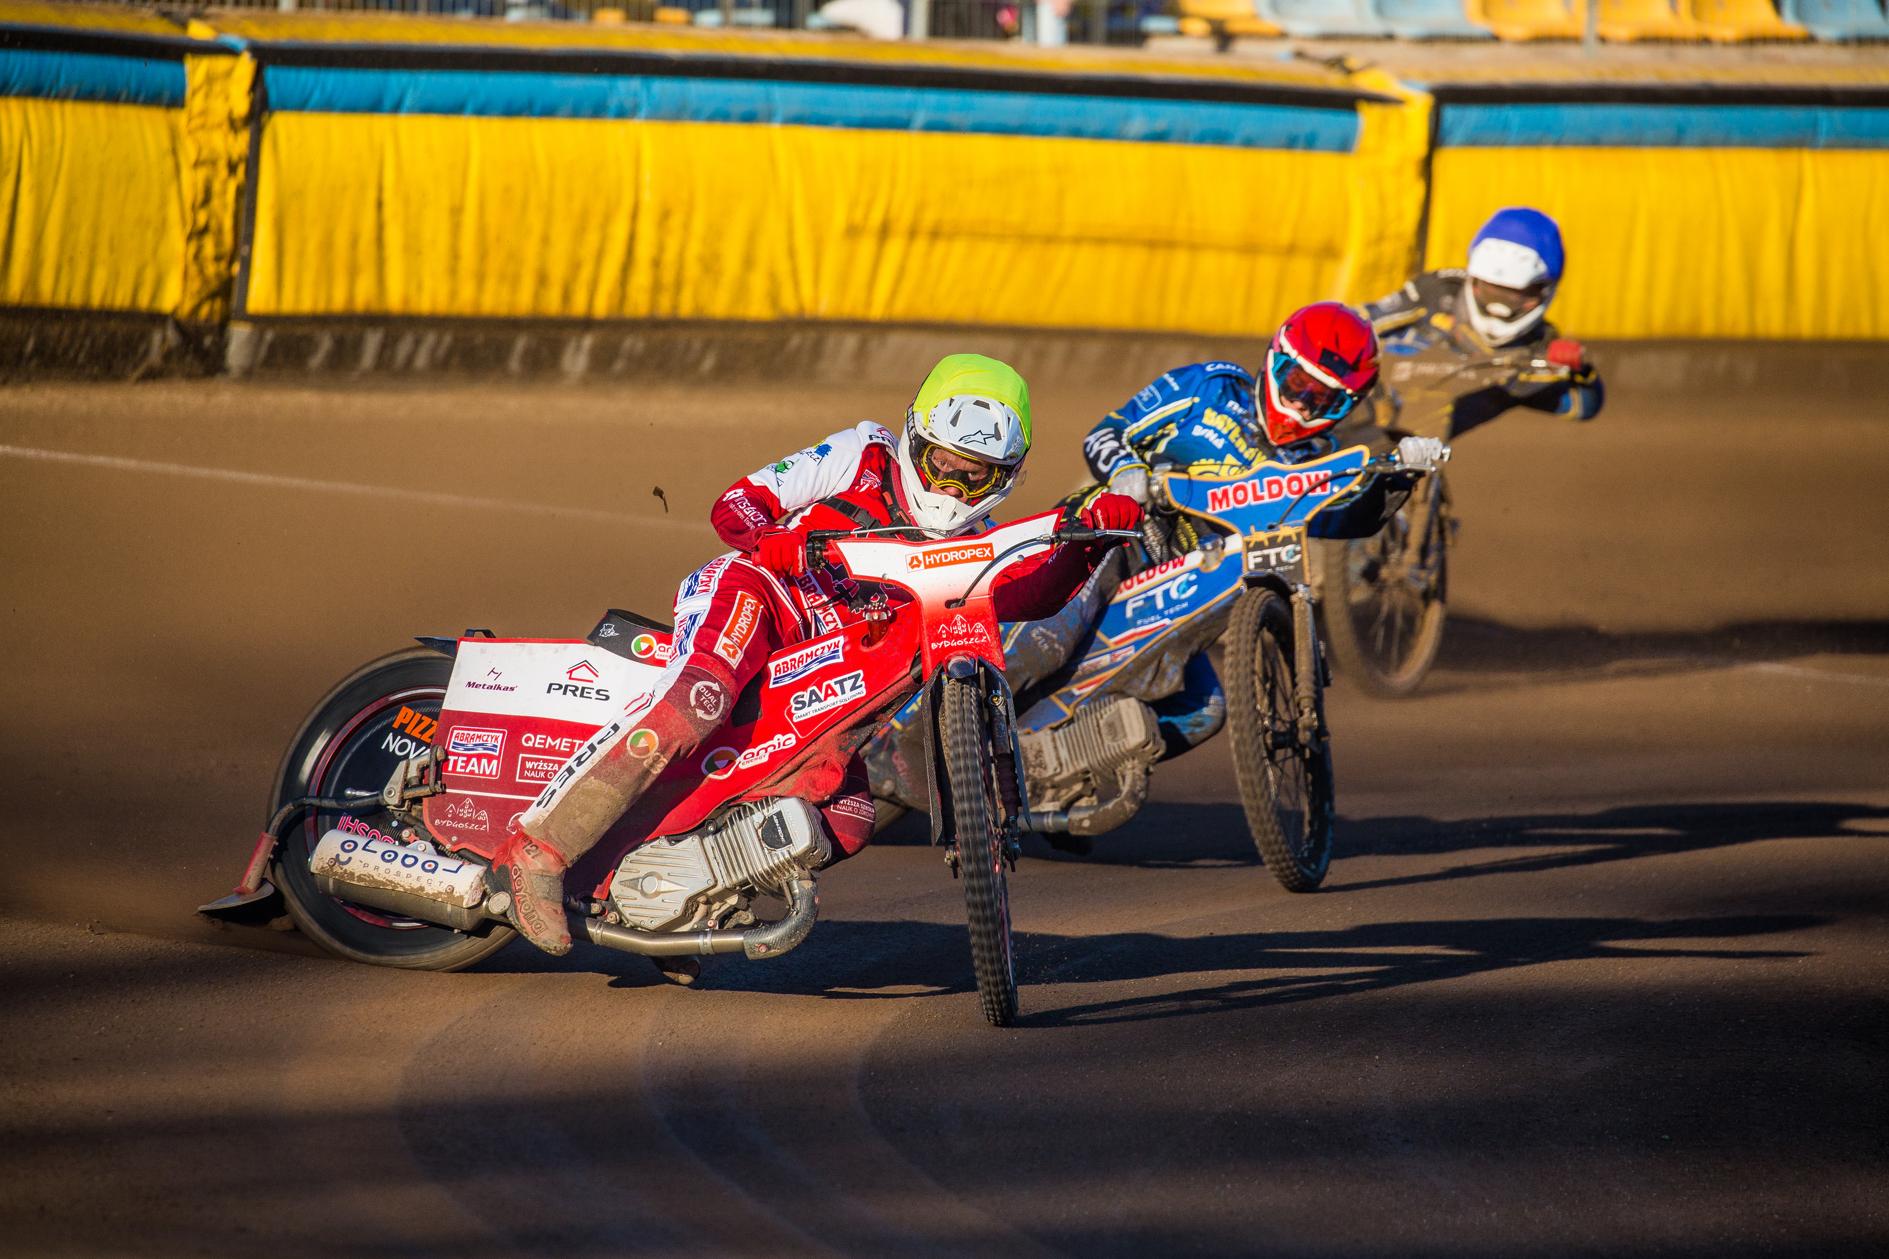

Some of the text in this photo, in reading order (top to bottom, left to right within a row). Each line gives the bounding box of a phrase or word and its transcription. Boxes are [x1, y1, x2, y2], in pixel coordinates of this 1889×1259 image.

[1209, 472, 1331, 512] MOLDOW
[925, 547, 992, 565] HYDROPEX
[1248, 544, 1302, 570] FTC
[1117, 554, 1187, 594] OLDOW
[1125, 573, 1198, 619] FTC
[729, 596, 758, 646] HYDROPEX
[931, 636, 987, 650] BYDGOSZCZ
[774, 640, 841, 678] ABRAMCZYK
[465, 681, 516, 692] Metalkas
[546, 682, 611, 701] PRES
[698, 685, 717, 706] DUAL
[793, 672, 863, 711] SAATZ
[700, 695, 717, 715] TECH
[794, 711, 811, 720] SMART
[811, 701, 838, 714] TRANSPORT
[454, 732, 501, 744] ABRAMCZYK
[522, 733, 587, 752] QEMET
[448, 755, 498, 776] TEAM
[524, 770, 546, 778] NAUK
[525, 760, 559, 771] WYŻSZA
[536, 723, 620, 809] PRES
[434, 819, 487, 831] BYDGOSZCZ
[362, 863, 444, 887] PROSPECT
[511, 864, 549, 936] daytona
